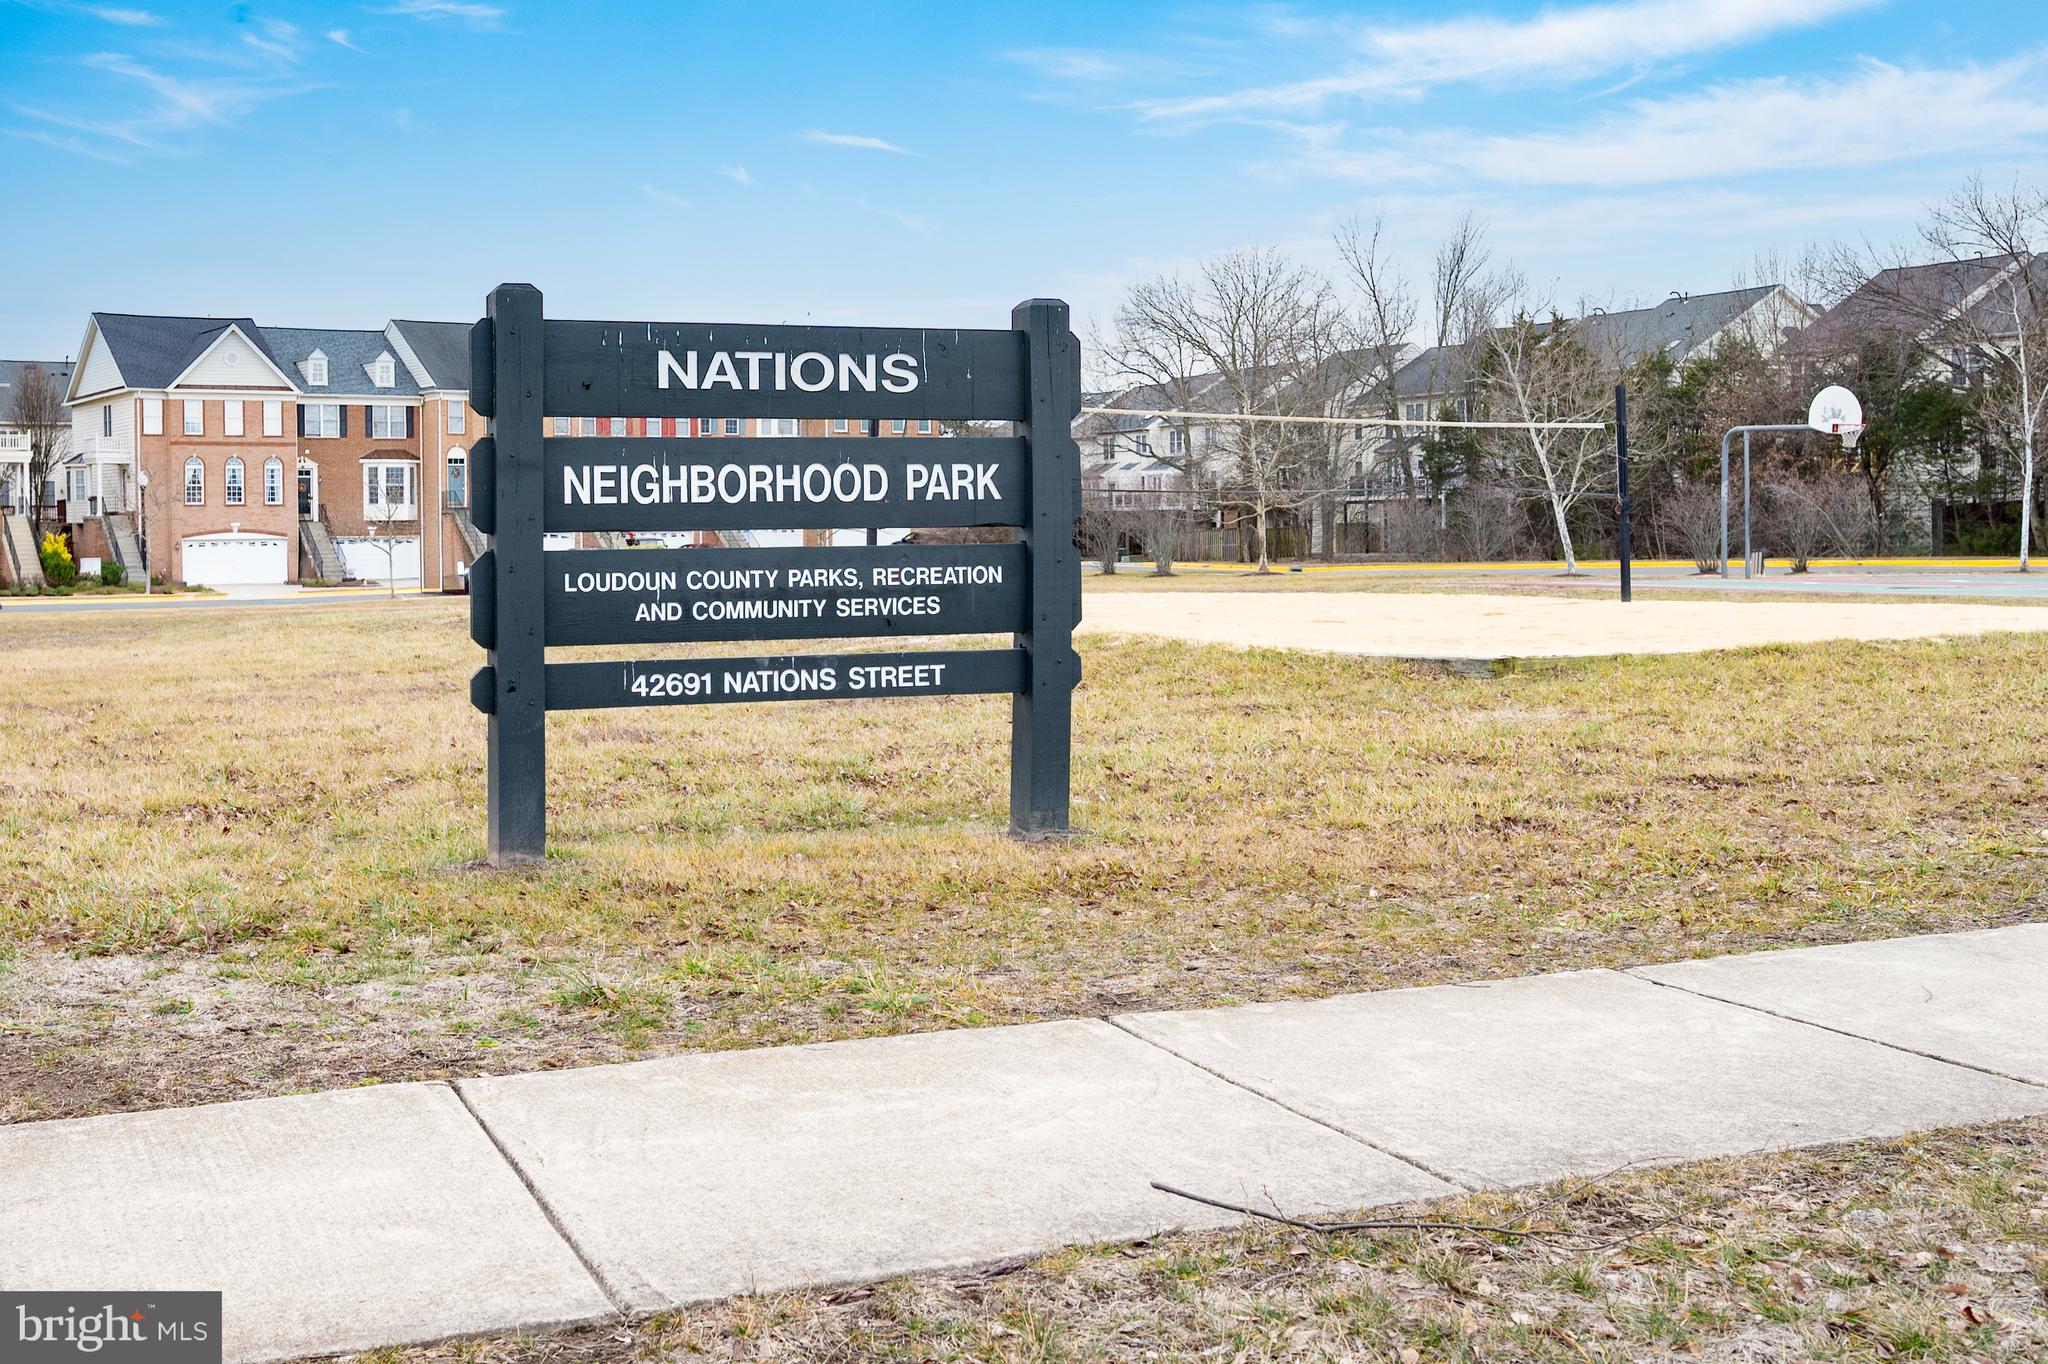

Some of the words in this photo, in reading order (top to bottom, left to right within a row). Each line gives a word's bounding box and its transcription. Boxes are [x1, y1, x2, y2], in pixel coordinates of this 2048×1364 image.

[657, 350, 919, 393] NATIONS
[563, 463, 889, 505] NEIGHBORHOOD
[906, 463, 1002, 501] PARK
[564, 571, 677, 593] LOUDOUN
[686, 569, 779, 590] COUNTY
[788, 567, 863, 589] PARKS,
[872, 565, 1003, 586] RECREATION
[634, 602, 683, 622] AND
[692, 599, 827, 621] COMMUNITY
[836, 595, 941, 617] SERVICES
[631, 672, 712, 697] 42691
[723, 667, 837, 694] NATIONS
[848, 664, 946, 690] STREET
